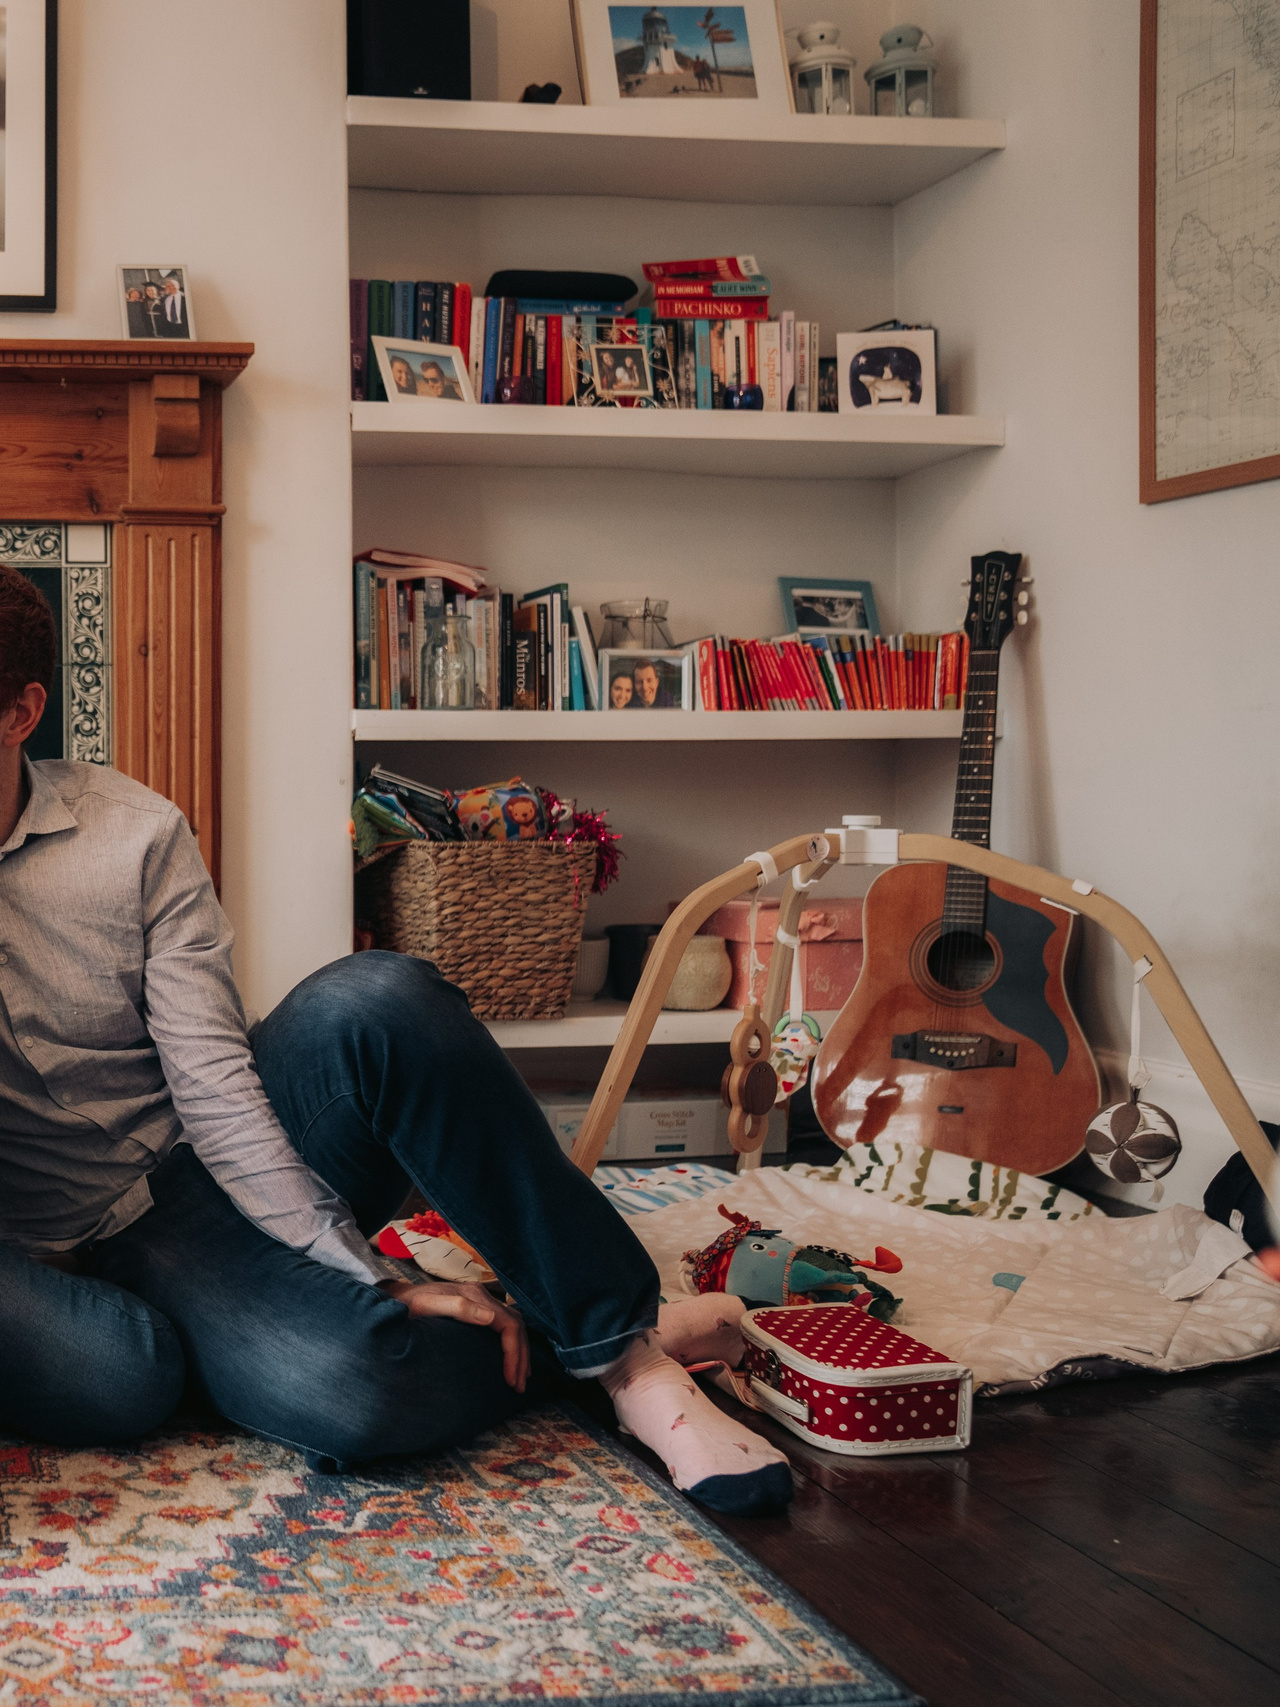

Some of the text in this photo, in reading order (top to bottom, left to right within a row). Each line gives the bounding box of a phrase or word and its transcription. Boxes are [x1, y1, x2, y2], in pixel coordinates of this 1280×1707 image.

[665, 285, 704, 295] MEMORIAM
[739, 284, 757, 293] WINN
[674, 302, 742, 315] PACHINKO
[441, 290, 450, 343] THE HUSBANDS
[763, 347, 779, 399] Sapiens
[516, 639, 529, 695] Munros
[649, 1109, 695, 1119] Cross Stitch
